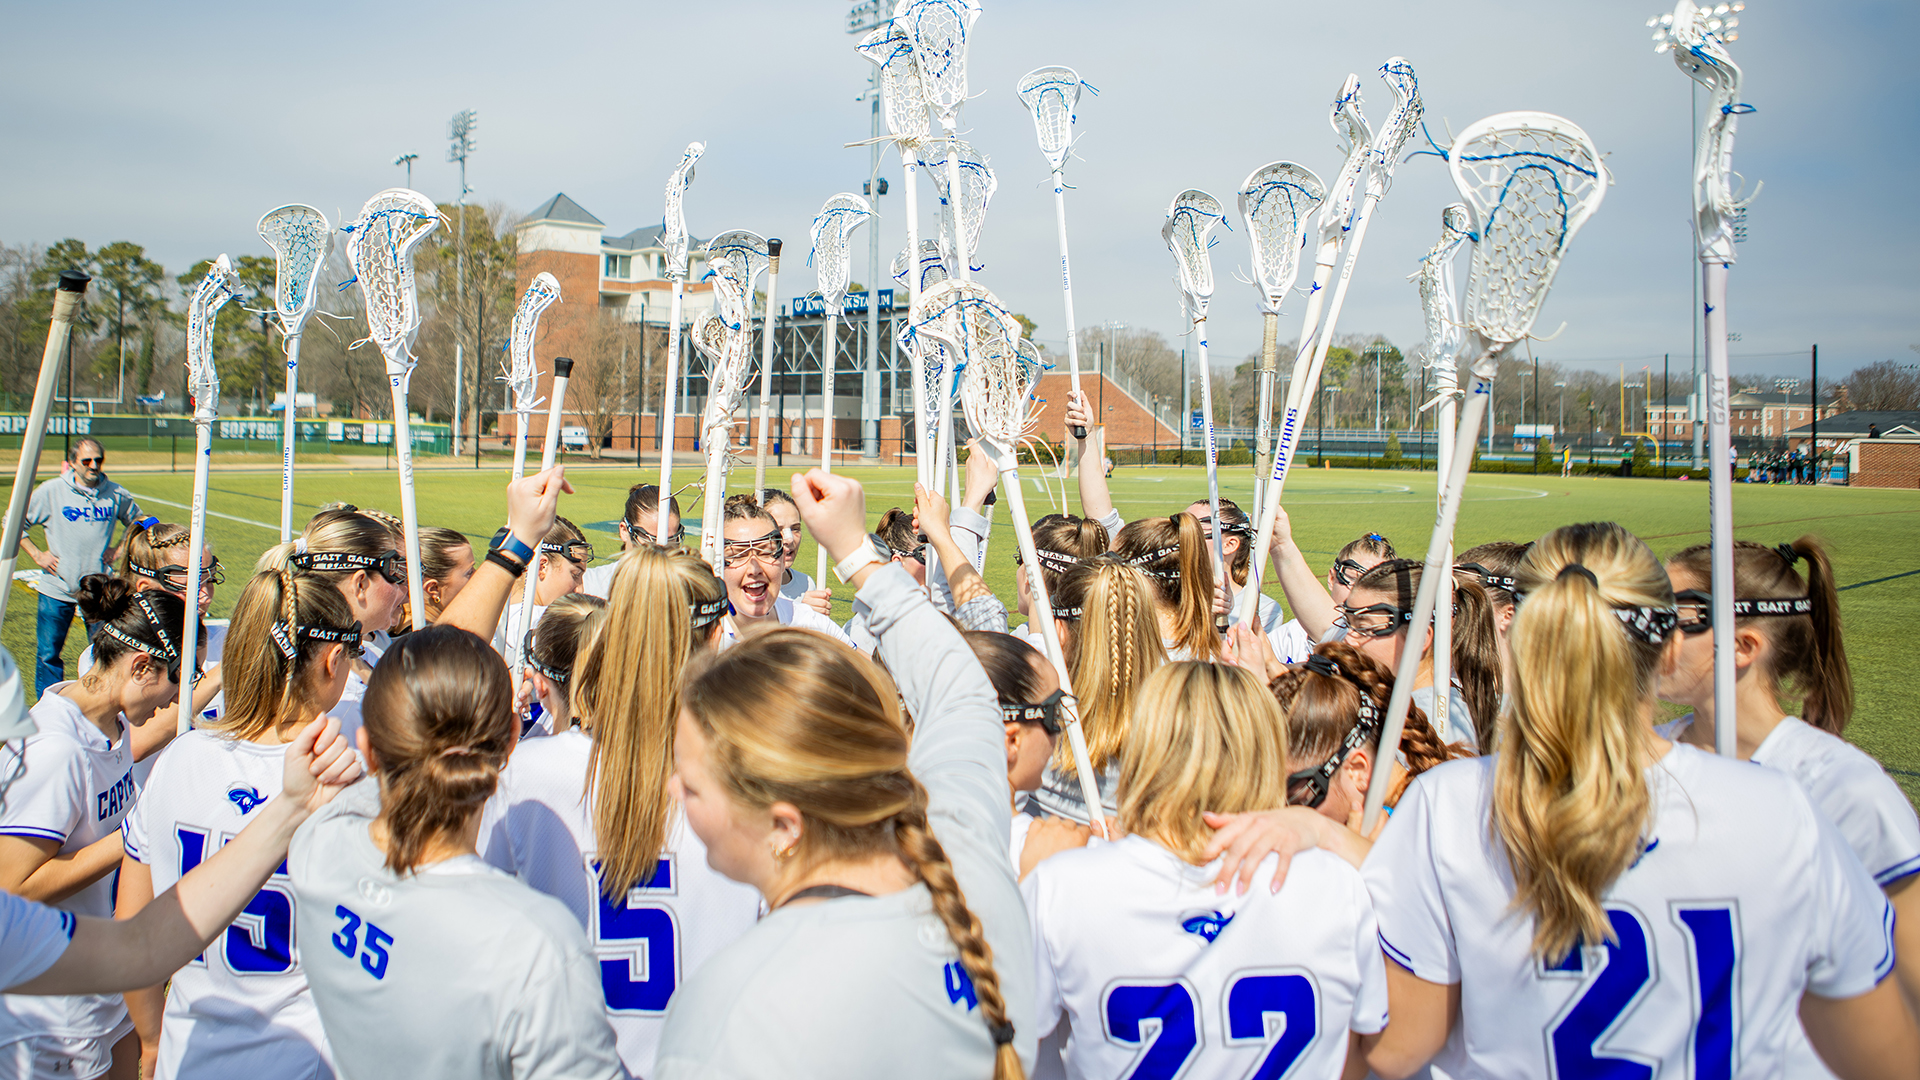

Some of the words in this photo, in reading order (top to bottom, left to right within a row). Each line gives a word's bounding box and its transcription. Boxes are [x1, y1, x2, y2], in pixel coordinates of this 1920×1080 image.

[1341, 252, 1355, 280] GAIT
[669, 329, 679, 356] GAIT
[1711, 374, 1725, 426] GAIT
[1273, 407, 1298, 481] CAPTAINS
[282, 446, 291, 492] CAPTAINS
[402, 451, 414, 488] GAIT
[193, 493, 203, 528] GAIT
[312, 552, 343, 562] GAIT
[346, 554, 377, 567] GAIT
[1129, 552, 1154, 566] GAIT
[1026, 564, 1040, 601] GAIT
[700, 601, 721, 615] GAIT
[1756, 600, 1792, 613] GAIT
[139, 600, 160, 625] GAIT
[157, 629, 179, 657] GAIT
[308, 628, 339, 641] GAIT
[340, 632, 359, 643] GAIT
[542, 668, 566, 682] GAIT
[331, 904, 395, 981] 35
[583, 851, 682, 1018] 5
[1532, 898, 1744, 1080] 21
[1098, 964, 1323, 1080] 22
